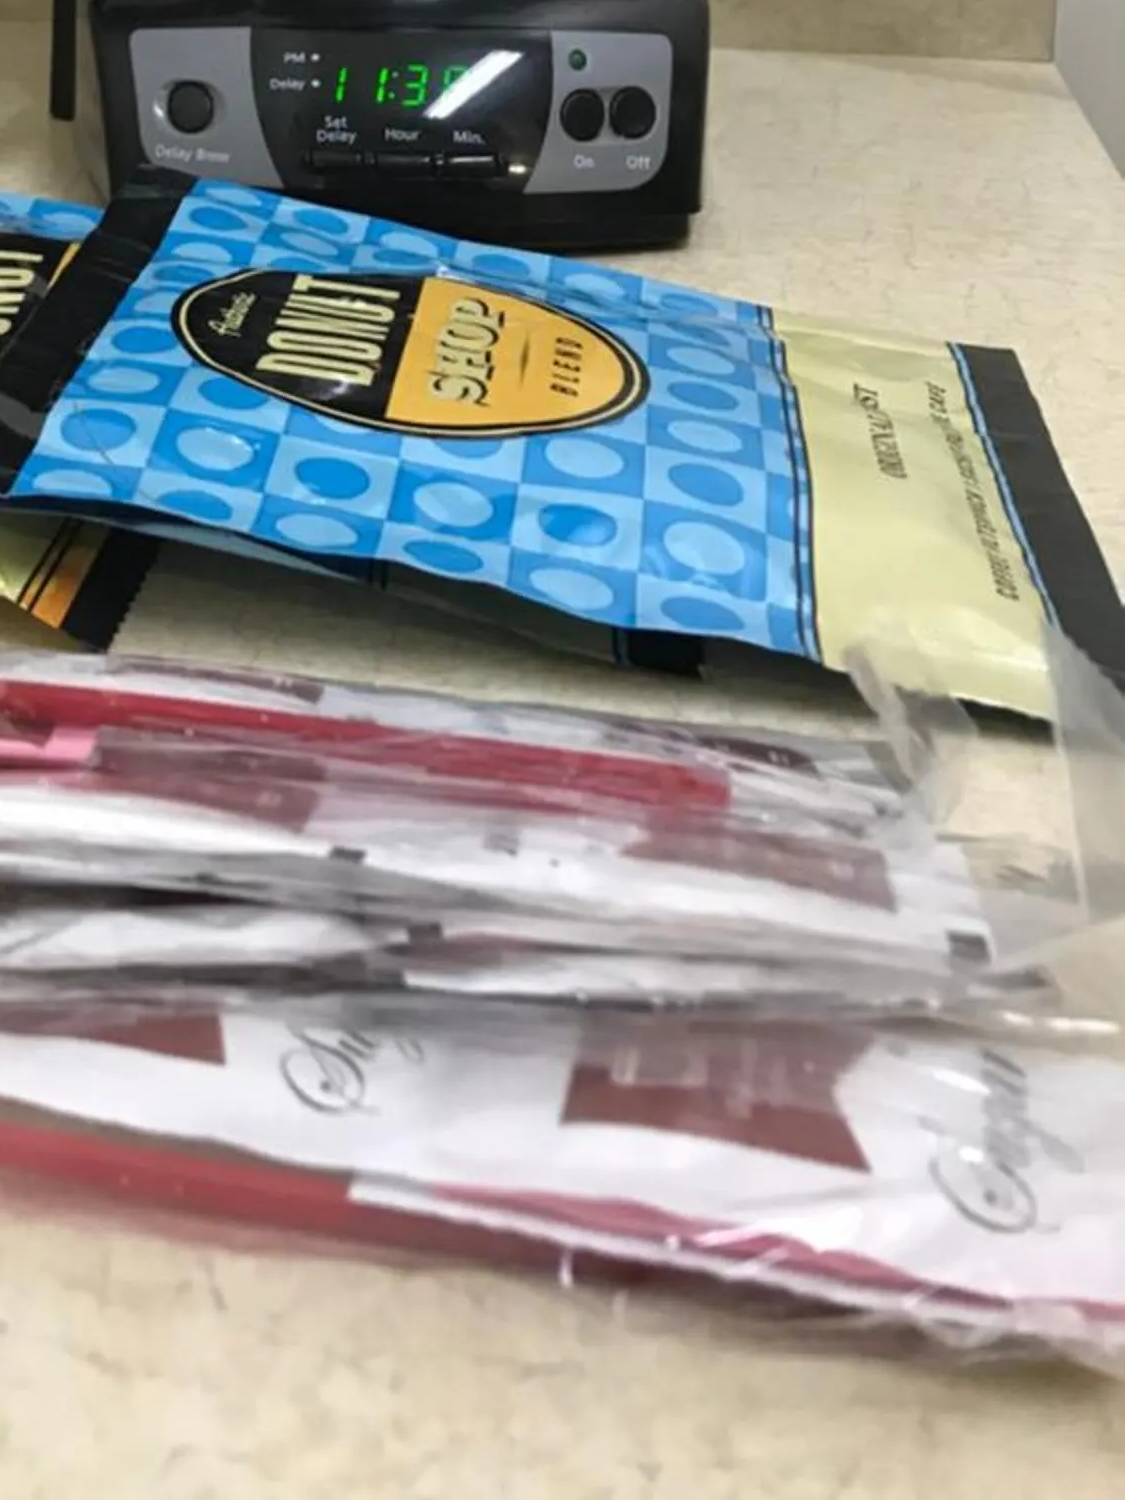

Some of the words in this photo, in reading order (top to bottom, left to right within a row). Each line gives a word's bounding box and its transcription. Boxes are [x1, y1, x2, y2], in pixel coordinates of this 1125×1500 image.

[284, 52, 306, 64] PM
[269, 77, 305, 91] Delay
[324, 114, 349, 130] Set
[315, 129, 358, 145] Delay
[384, 128, 421, 142] Hour
[626, 155, 651, 171] Off
[255, 273, 401, 388] DONUT
[429, 296, 507, 407] SHOP
